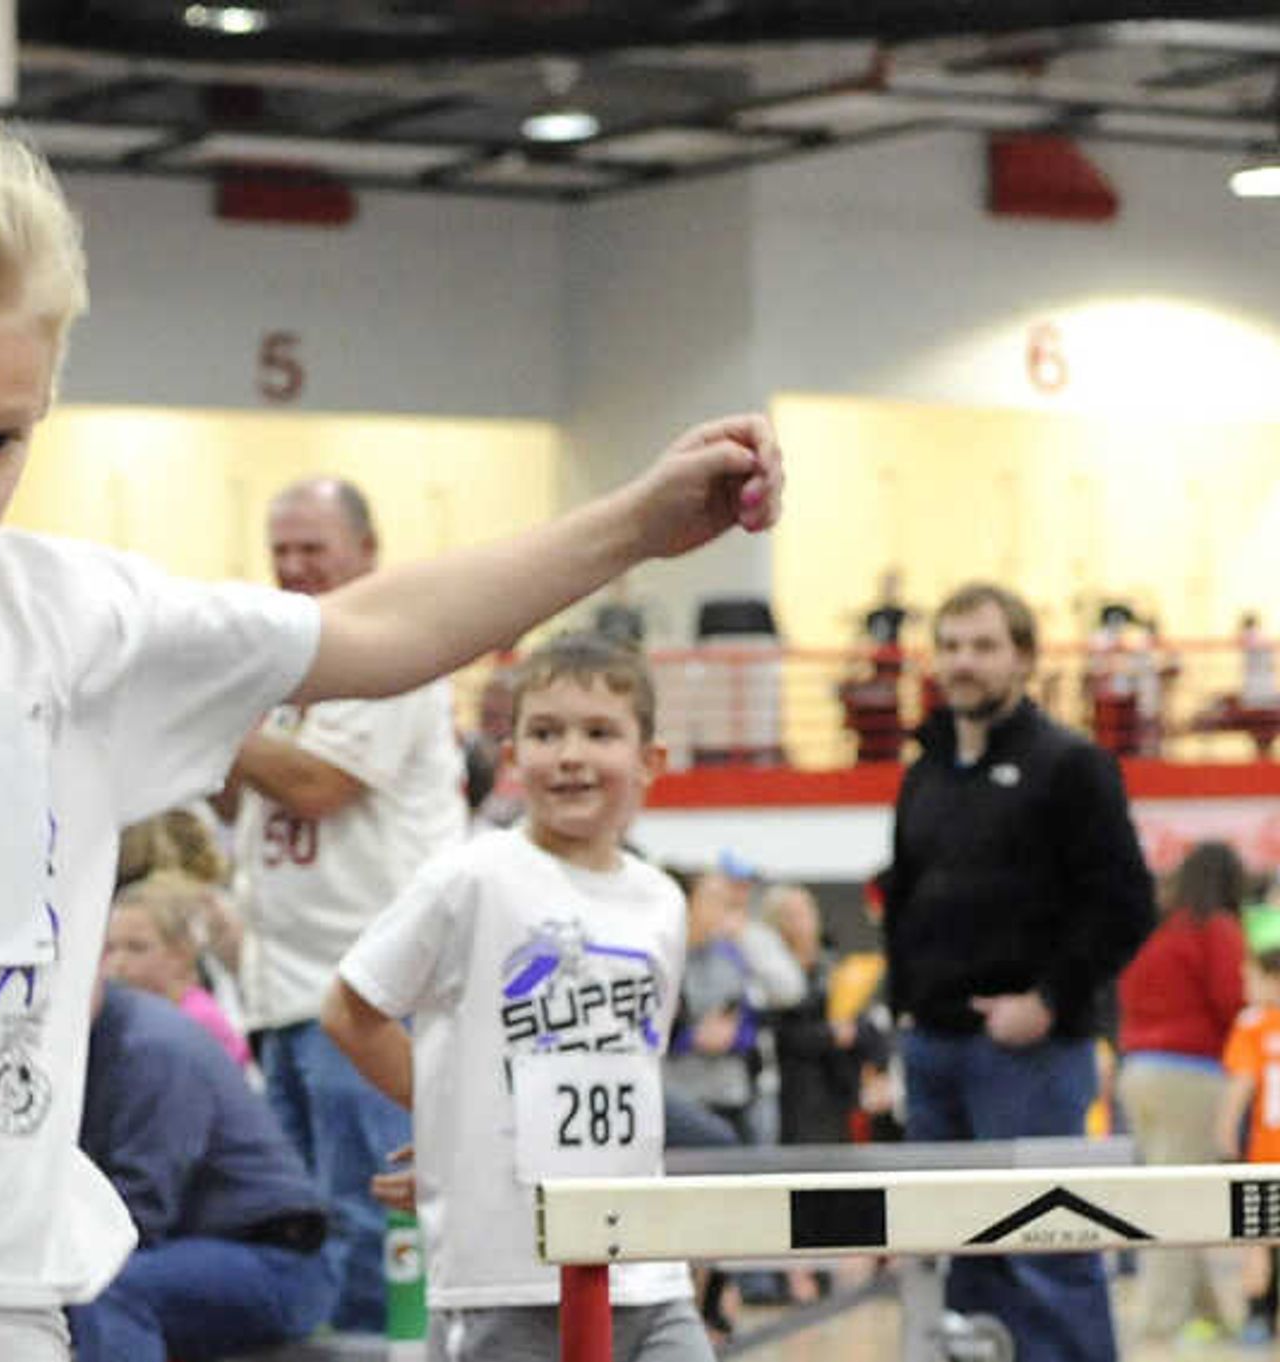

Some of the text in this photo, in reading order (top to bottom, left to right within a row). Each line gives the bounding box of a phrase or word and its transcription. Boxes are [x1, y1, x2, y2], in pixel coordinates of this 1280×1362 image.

[257, 330, 307, 404] 5
[1025, 320, 1070, 397] 6
[556, 1083, 636, 1147] 285
